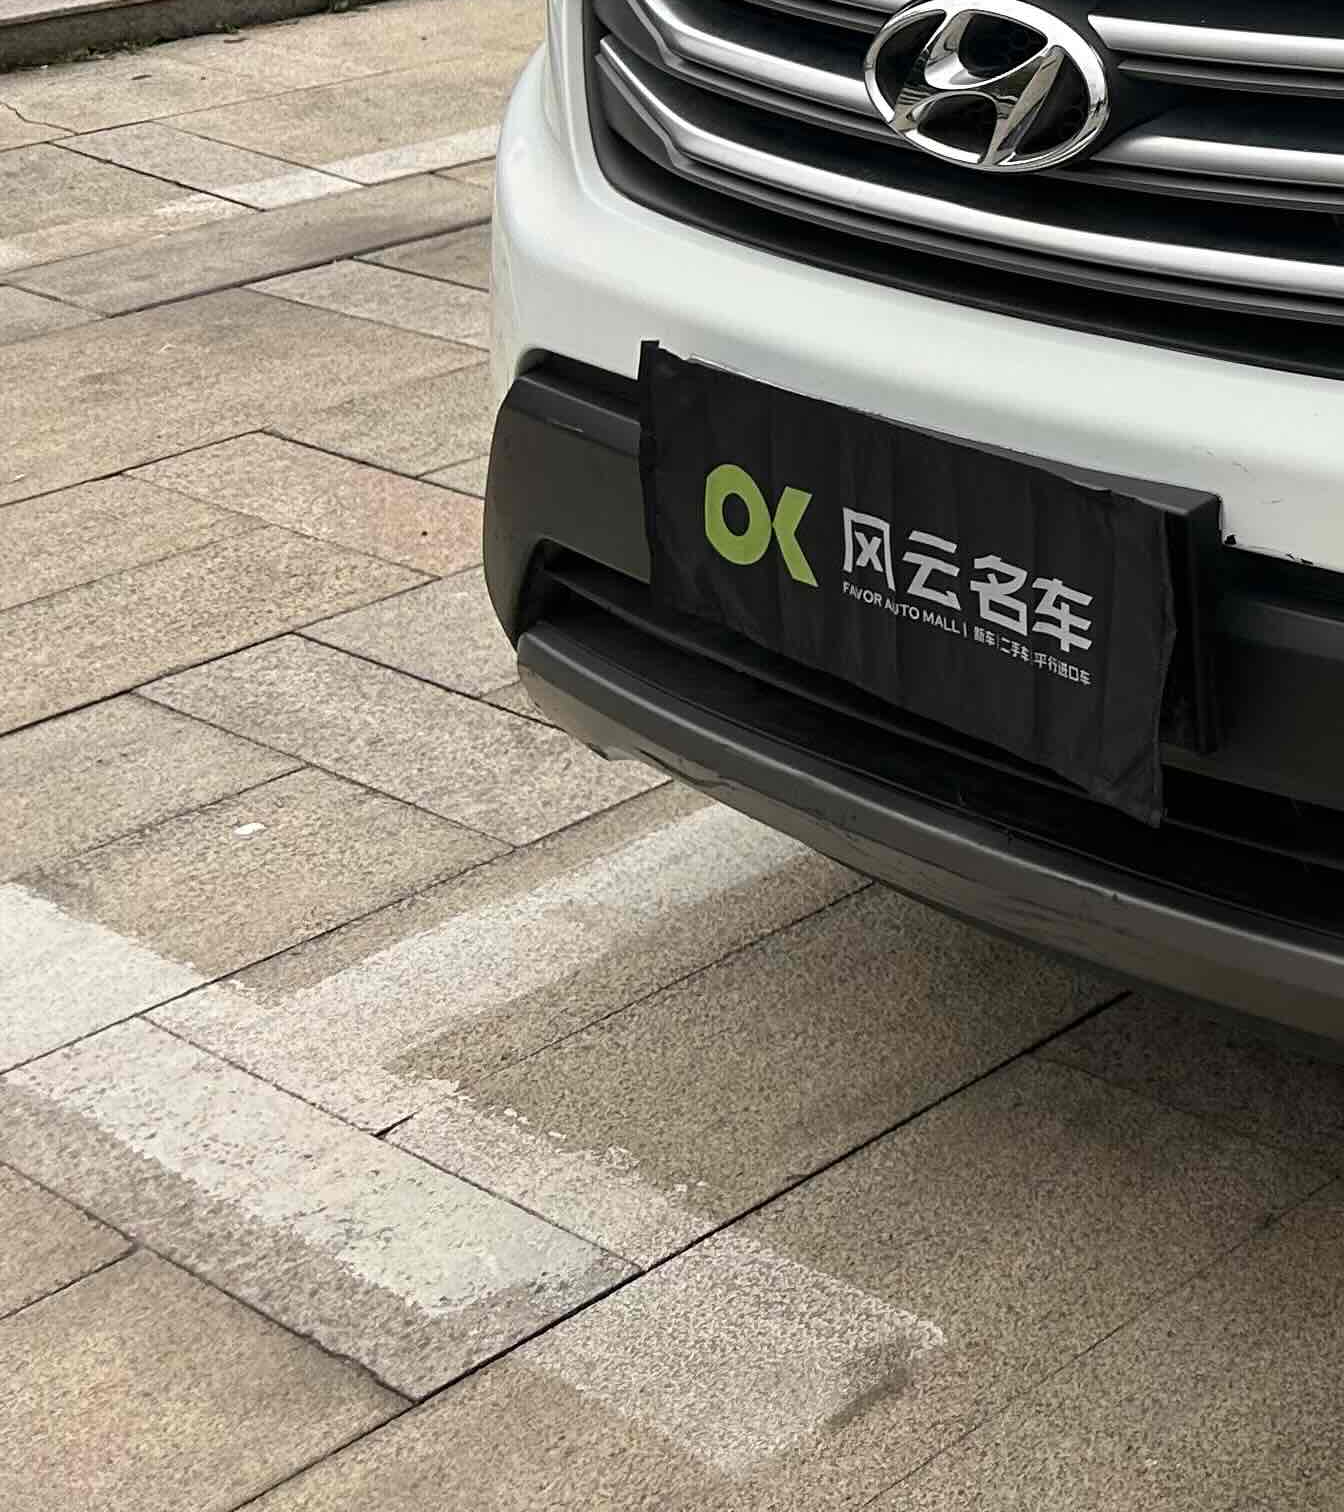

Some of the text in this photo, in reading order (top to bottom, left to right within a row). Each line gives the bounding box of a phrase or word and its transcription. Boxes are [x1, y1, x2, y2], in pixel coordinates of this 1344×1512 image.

[704, 464, 818, 587] OK
[842, 506, 1093, 653] 风云名车
[842, 581, 961, 635] FAVOR AUTO MALL
